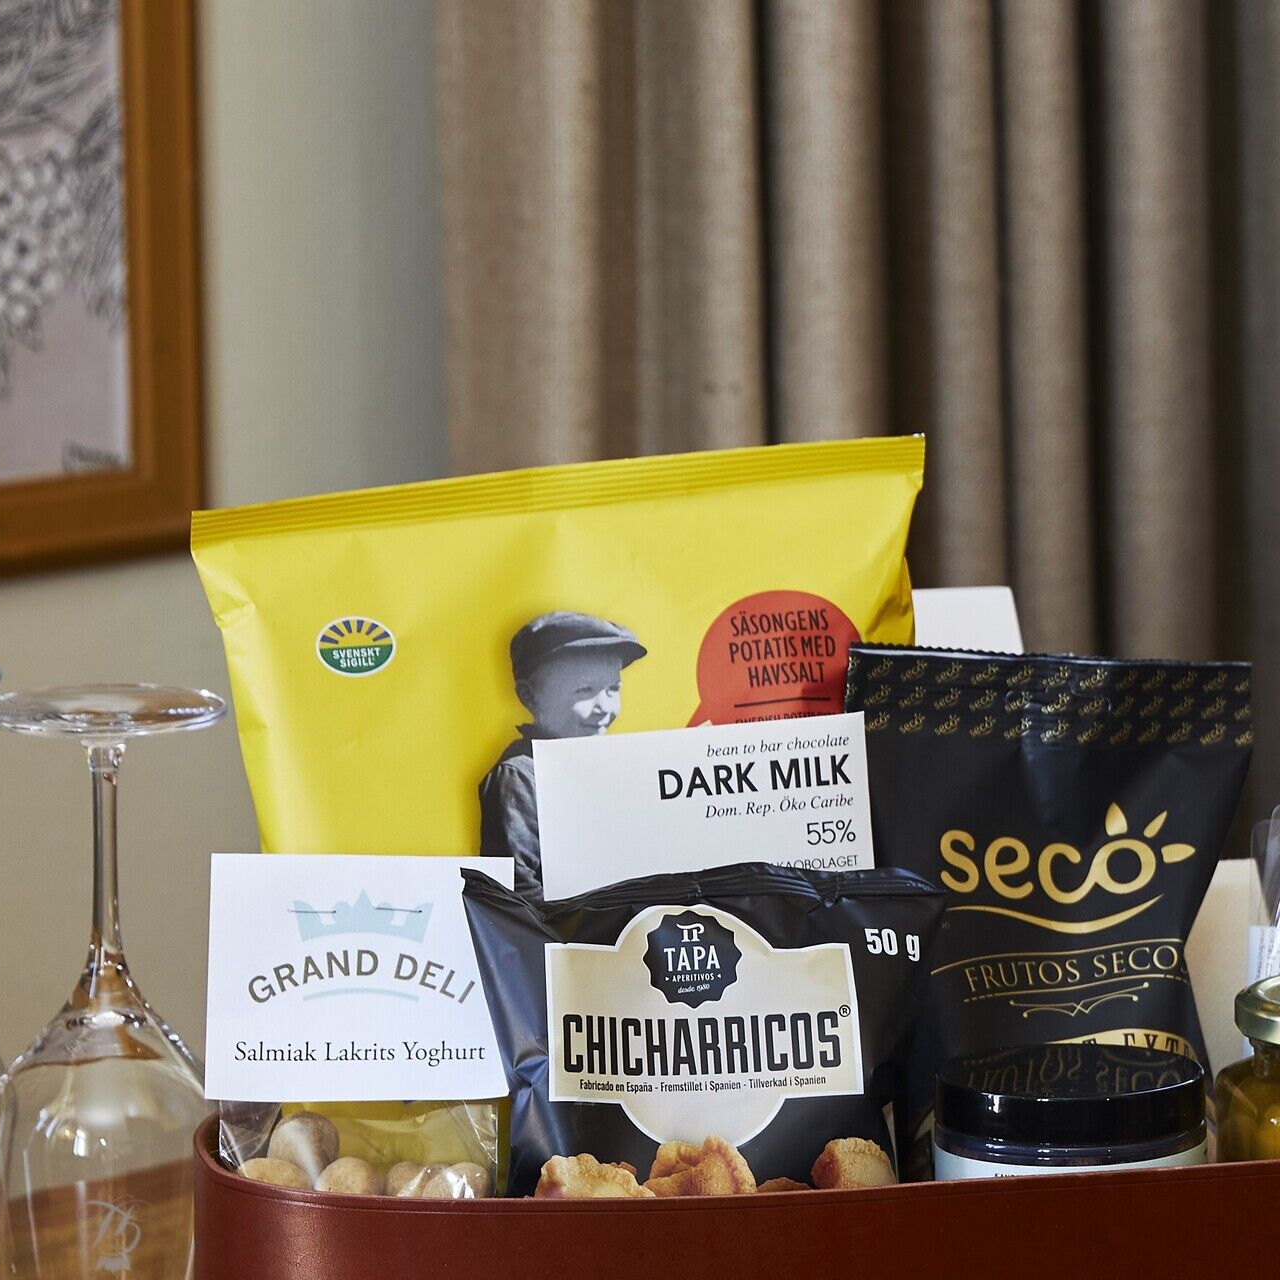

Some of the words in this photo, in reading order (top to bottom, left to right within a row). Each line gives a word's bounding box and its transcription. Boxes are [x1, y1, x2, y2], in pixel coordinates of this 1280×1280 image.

[730, 608, 829, 637] SÄSONGENS
[332, 647, 381, 660] SVENSKT
[729, 637, 798, 664] POTATIS
[800, 636, 836, 658] MED
[747, 661, 826, 688] HAVSSALT
[707, 744, 738, 757] bean
[743, 743, 756, 754] to
[760, 740, 783, 753] bar
[786, 734, 850, 750] chocolate
[658, 761, 758, 800] DARK
[770, 753, 852, 790] MILK
[706, 804, 742, 818] Dom.
[746, 801, 775, 817] Rep.
[779, 796, 807, 812] Öko
[810, 794, 854, 809] Caribe
[806, 819, 856, 845] 55%
[940, 829, 1157, 904] seco
[664, 945, 720, 972] TAPA
[863, 928, 898, 956] 50
[906, 934, 920, 962] g
[248, 948, 379, 1004] GRAND
[394, 953, 476, 1004] DELI
[672, 973, 715, 982] APERITIVOS
[964, 958, 1081, 993] FRUTOS
[1093, 944, 1187, 978] SECO
[677, 985, 695, 994] desde
[234, 1041, 317, 1062] Salmiak
[324, 1041, 396, 1062] Lakrits
[402, 1041, 486, 1068] Yoghurt
[580, 1079, 614, 1092] Fabricado
[615, 1082, 625, 1092] en
[626, 1081, 652, 1094] España
[660, 1081, 703, 1092] Fremstillet
[709, 1080, 741, 1093] Spanien
[749, 1077, 787, 1089] Tillverkad
[794, 1075, 826, 1088] Spanien
